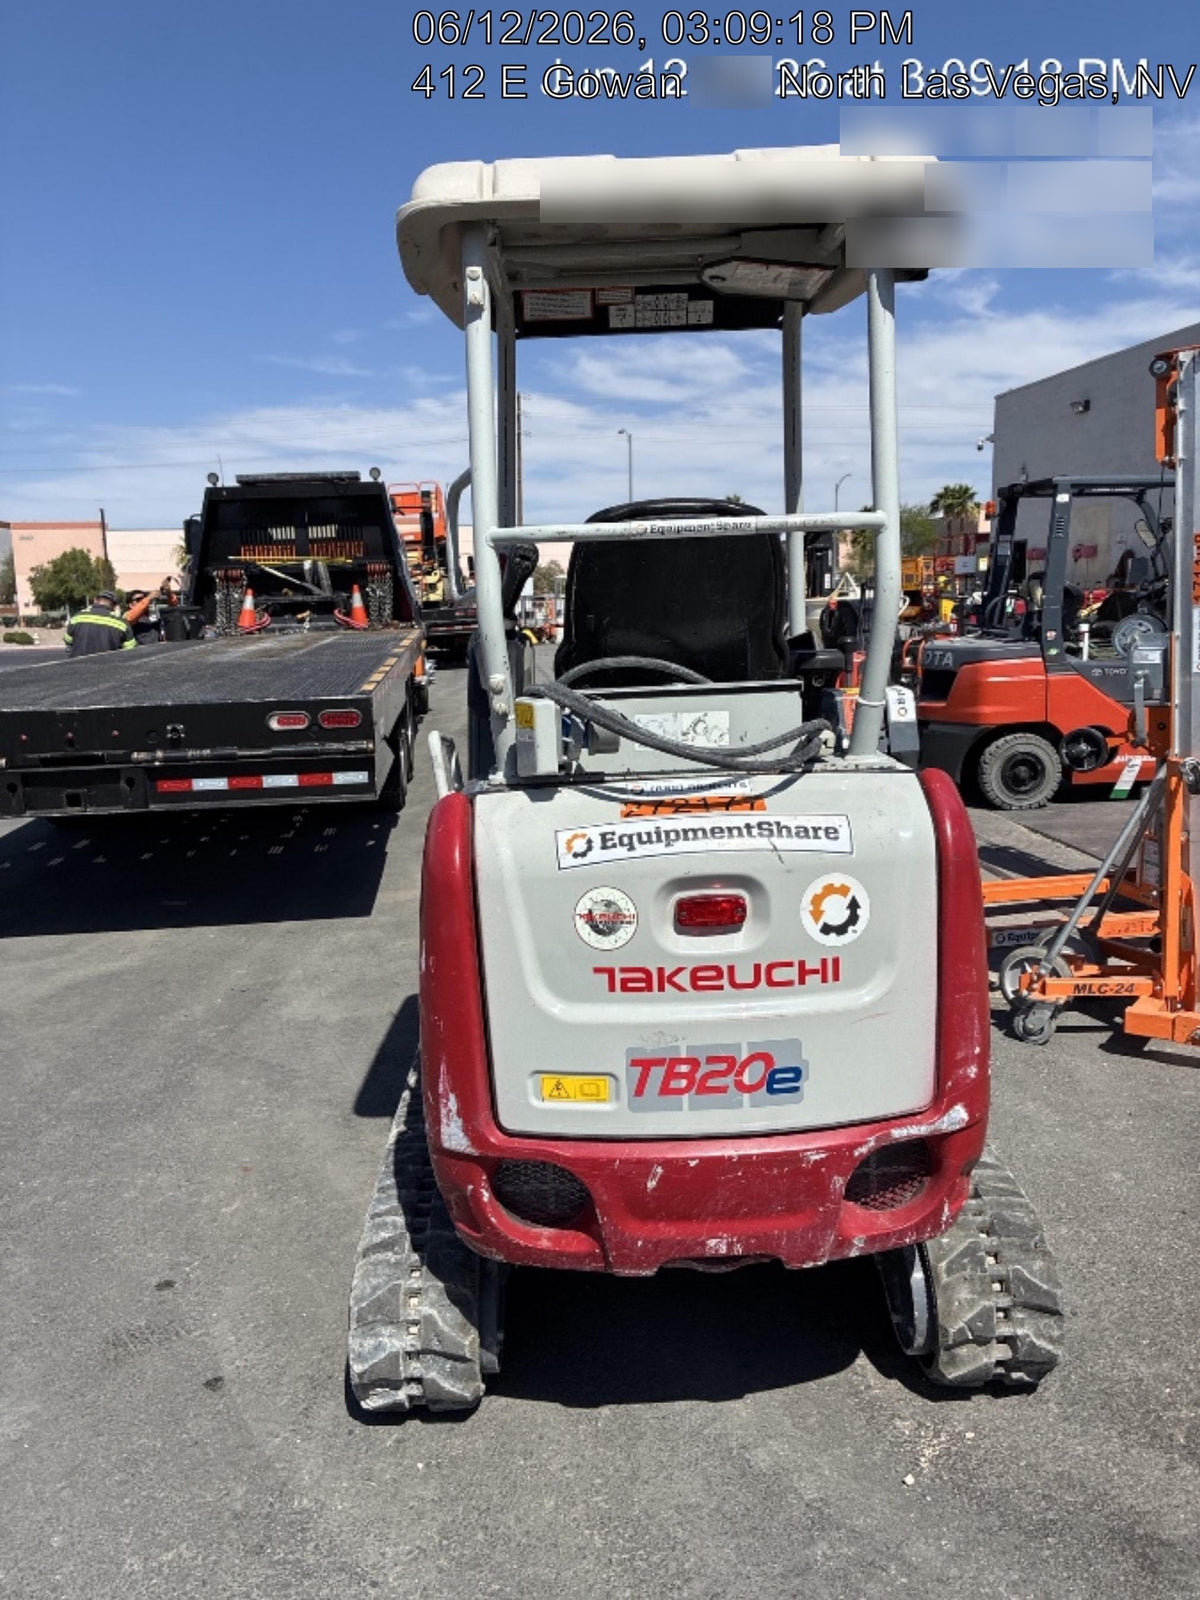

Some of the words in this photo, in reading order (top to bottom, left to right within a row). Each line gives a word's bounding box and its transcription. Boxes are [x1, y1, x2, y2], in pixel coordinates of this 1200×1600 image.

[599, 820, 841, 852] EquipmentShare
[593, 956, 841, 993] TAKEUCHI
[1073, 982, 1136, 995] MLC-24
[629, 1051, 803, 1098] TB20e
